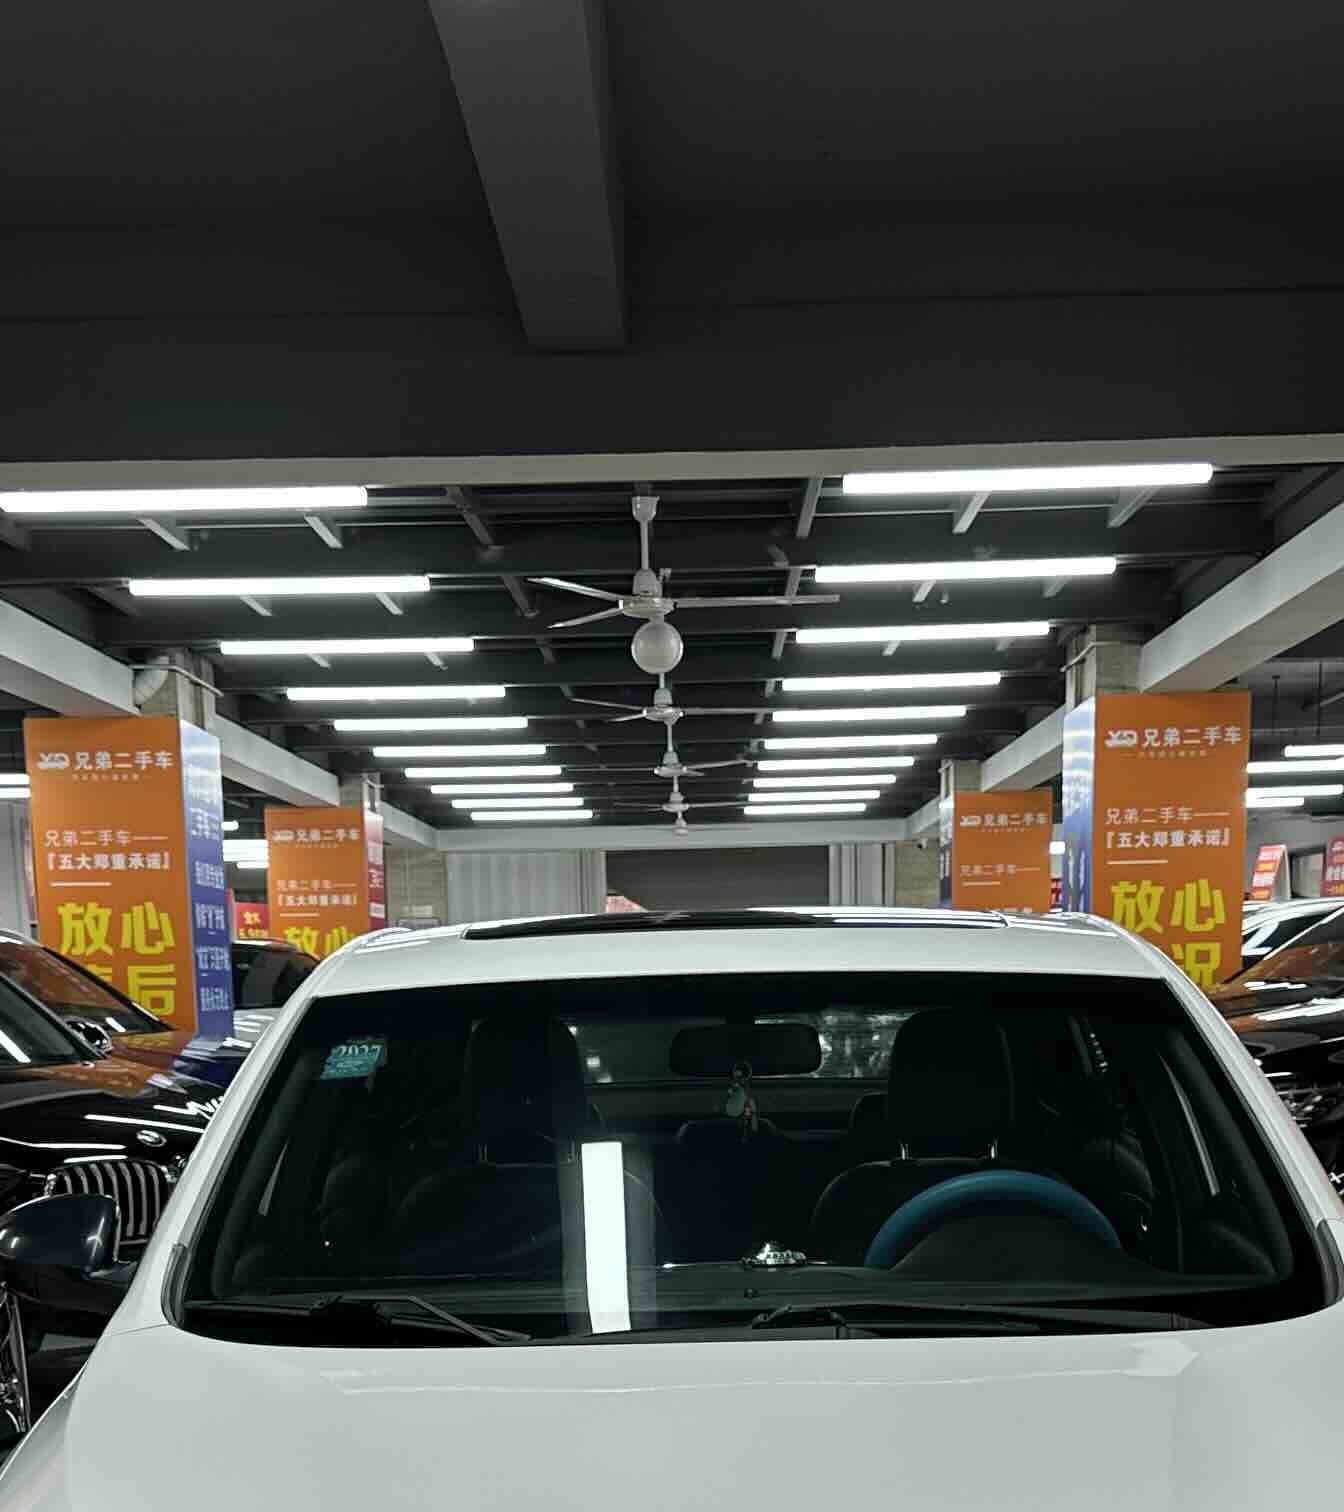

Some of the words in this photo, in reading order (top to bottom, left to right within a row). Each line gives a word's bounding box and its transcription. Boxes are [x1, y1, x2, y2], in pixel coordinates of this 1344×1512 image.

[1141, 725, 1243, 747] 兄弟二手车
[74, 750, 174, 770] 兄弟二手车
[1110, 879, 1226, 935] 放心
[57, 900, 176, 956] 放心
